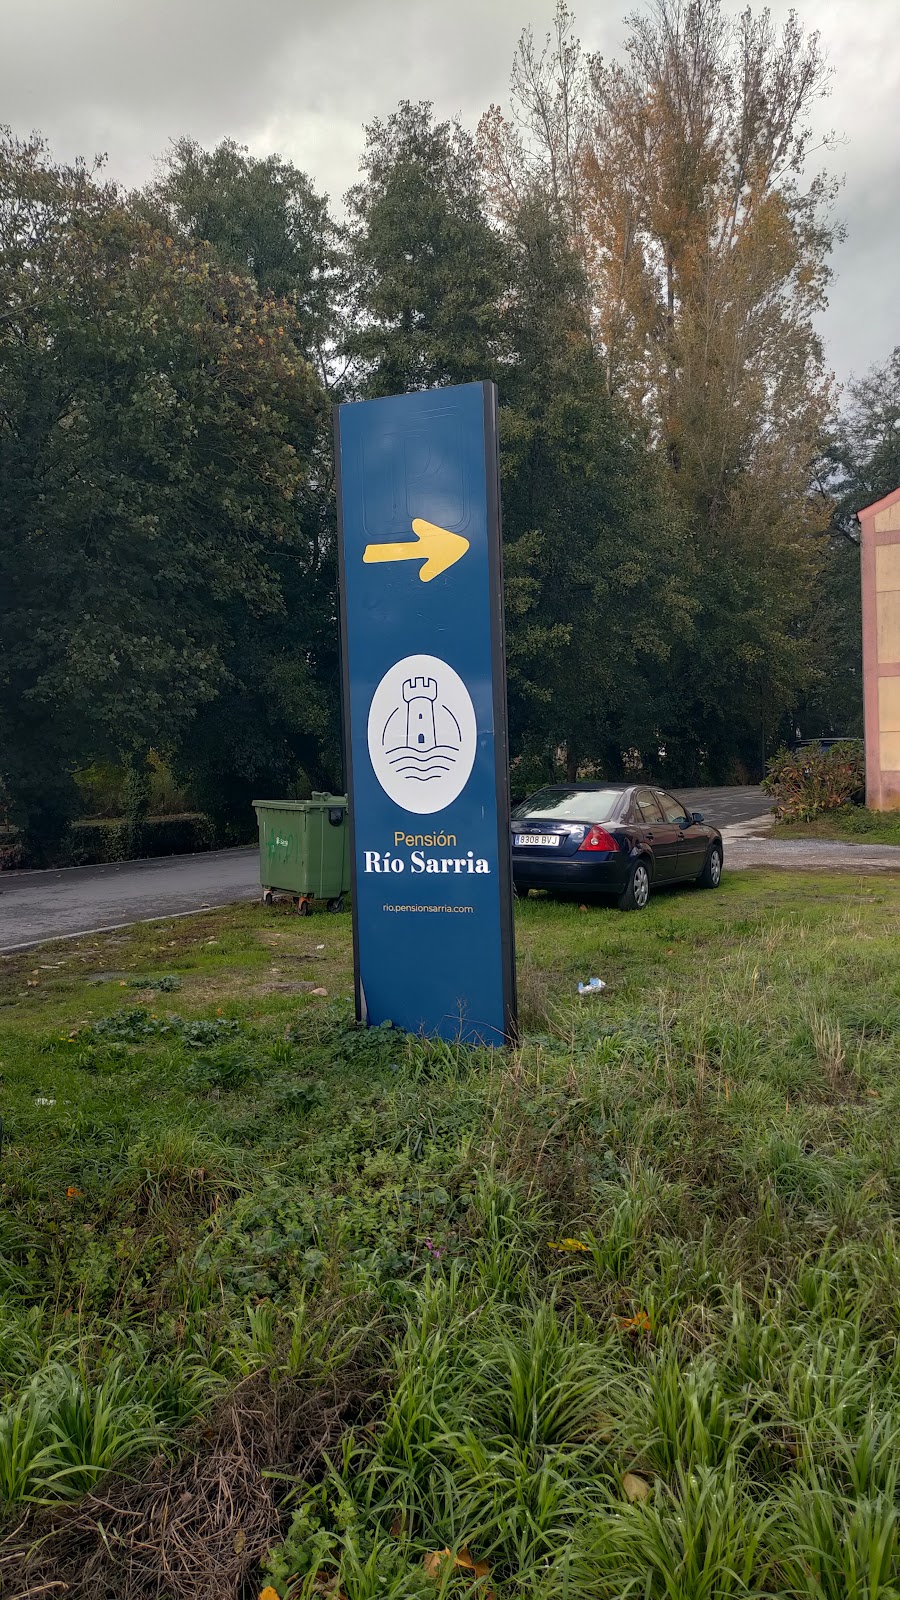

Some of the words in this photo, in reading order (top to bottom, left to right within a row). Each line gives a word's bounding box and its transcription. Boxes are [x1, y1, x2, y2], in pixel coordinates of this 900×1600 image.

[394, 830, 457, 846] Pensión
[520, 835, 540, 844] 8308
[541, 835, 557, 844] BVJ
[363, 850, 405, 873] Río
[410, 850, 491, 874] Sarria
[382, 903, 474, 914] rio.pensionsarria.com
